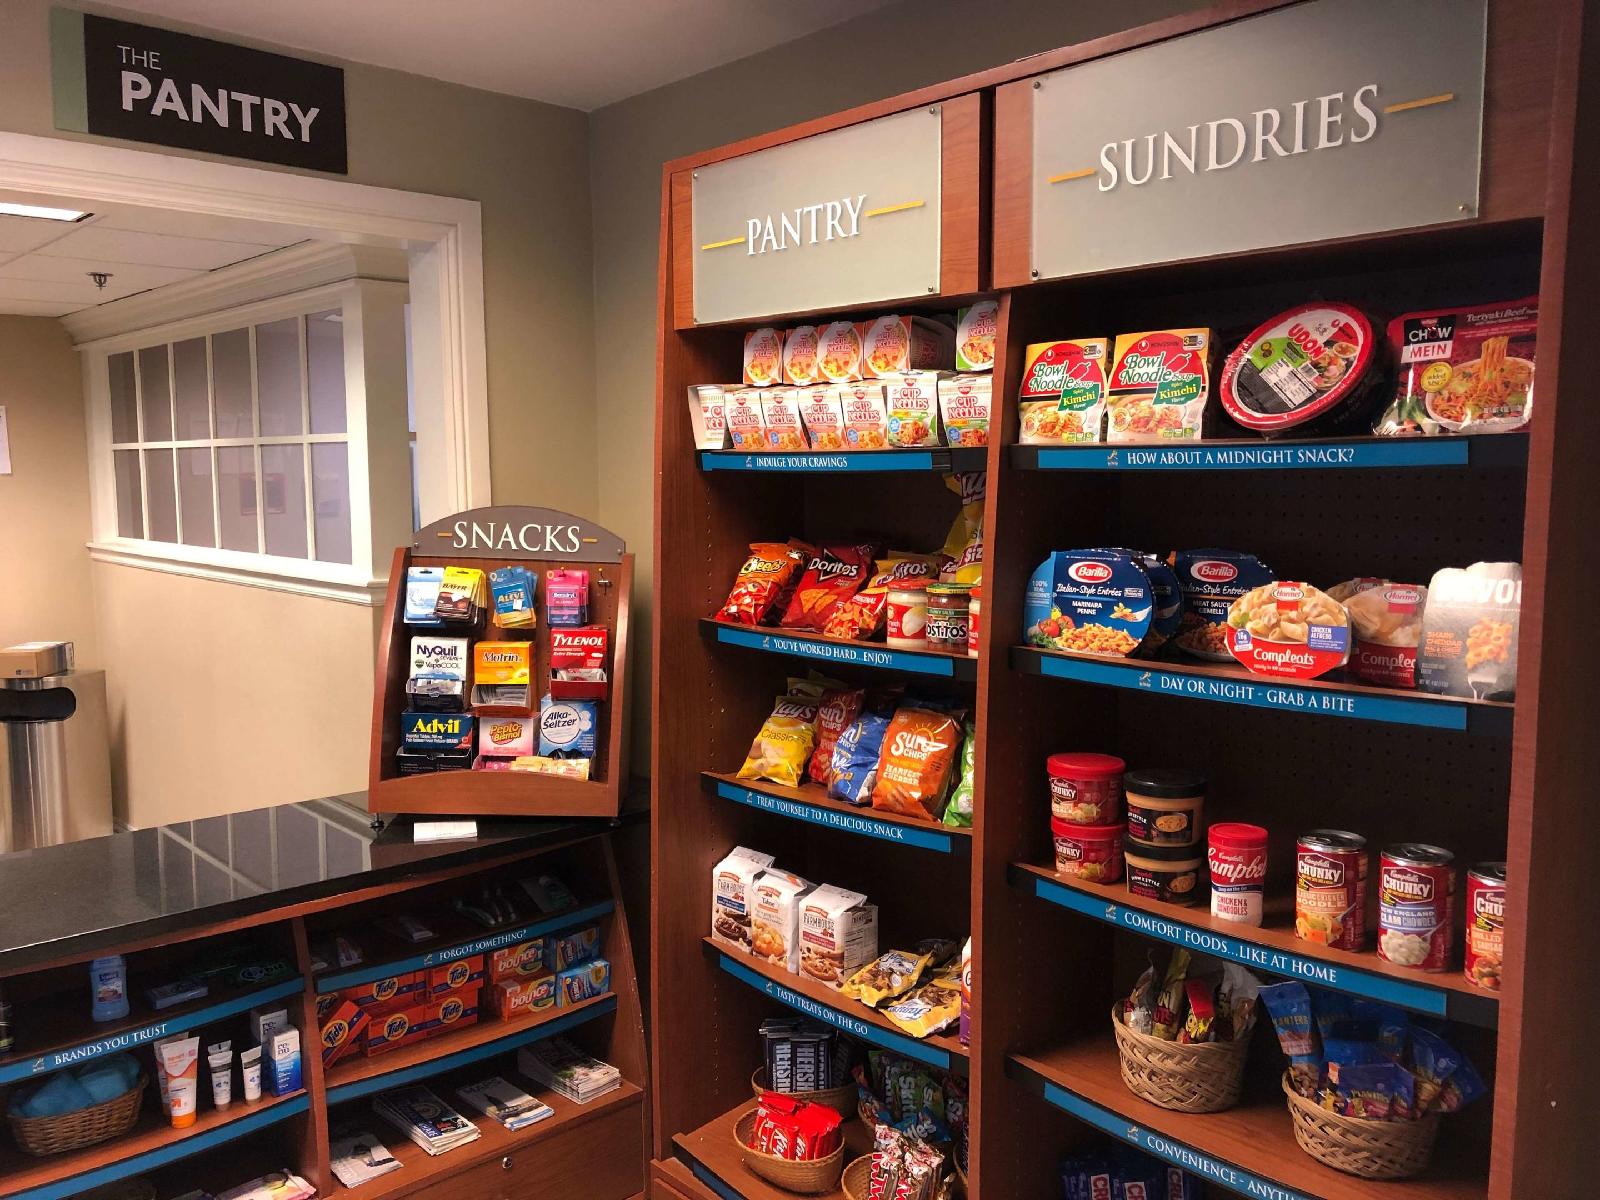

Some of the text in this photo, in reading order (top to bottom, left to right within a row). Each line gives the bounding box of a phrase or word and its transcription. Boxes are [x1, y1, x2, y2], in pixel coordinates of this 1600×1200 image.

[117, 45, 161, 70] THE
[121, 70, 320, 142] PANTRY
[1097, 84, 1380, 193] SUNDRIES
[746, 194, 868, 256] PANTRY
[1287, 323, 1328, 361] UDON
[1410, 343, 1447, 358] MEIN
[1033, 360, 1069, 377] Bowl
[1124, 351, 1166, 369] Bowl
[1029, 375, 1074, 392] Noodle
[1119, 367, 1172, 385] Noodle
[1063, 391, 1096, 406] Kimchi
[1159, 384, 1197, 399] Kimchi
[756, 456, 848, 468] INDULGE YOUR CRAVINGS
[1127, 448, 1354, 464] HOW ABOUT A MIDNIGHT SNACK?
[453, 520, 580, 553] SNACKS
[808, 557, 858, 577] Doritos
[1078, 566, 1108, 577] Barilla
[1200, 565, 1234, 577] Barilla
[442, 583, 468, 591] BAYER
[1056, 583, 1096, 597] Italian-Style
[1276, 588, 1301, 598] Hormel
[1072, 600, 1103, 609] MARINARA
[1389, 592, 1419, 601] Hormel
[927, 621, 967, 639] OSTITOS
[553, 633, 603, 647] TYLENOL
[774, 638, 798, 652] YOU'VE
[799, 643, 832, 657] WORKED
[416, 644, 458, 658] NyQuil
[483, 652, 519, 663] Motrin
[1253, 648, 1315, 665] Compleats
[1161, 676, 1185, 690] DAY
[1187, 680, 1206, 694] OR
[1209, 682, 1254, 700] NIGHT
[1267, 690, 1304, 706] GRAB
[1308, 695, 1318, 708] A
[1322, 696, 1355, 713] BITE
[545, 711, 571, 721] Alka-
[771, 702, 817, 719] Lay's
[411, 718, 460, 733] Advil
[490, 722, 522, 735] Pepto-
[542, 718, 577, 730] Seltzer
[494, 731, 521, 741] Bismol
[904, 748, 928, 761] CHIPS
[757, 796, 904, 839] TREAT YOURSELF TO A DELICIOUS SNACK
[1299, 861, 1341, 883] CHUNKY
[717, 878, 745, 895] FARMHOUSE
[1383, 873, 1431, 897] CHUNKY
[1394, 910, 1435, 918] ENGLAND
[1476, 897, 1505, 916] CHU
[803, 912, 835, 931] FARMHOUSE
[1381, 913, 1402, 925] CLAM
[439, 929, 527, 961] FORGOT SOMETHING?
[1124, 912, 1182, 940] COMFORT
[1271, 954, 1287, 969] AT
[1292, 959, 1337, 983] HOME
[449, 968, 468, 984] Tide
[376, 980, 396, 996] Tide
[441, 1003, 462, 1021] Tide
[776, 987, 868, 1035] TASTY TREATS ON THE GO
[324, 1023, 344, 1047] Tide
[386, 1019, 407, 1037] Tide
[54, 1023, 167, 1065] BRANDS YOU TRUST
[1147, 1136, 1237, 1184] CONVENIENCE
